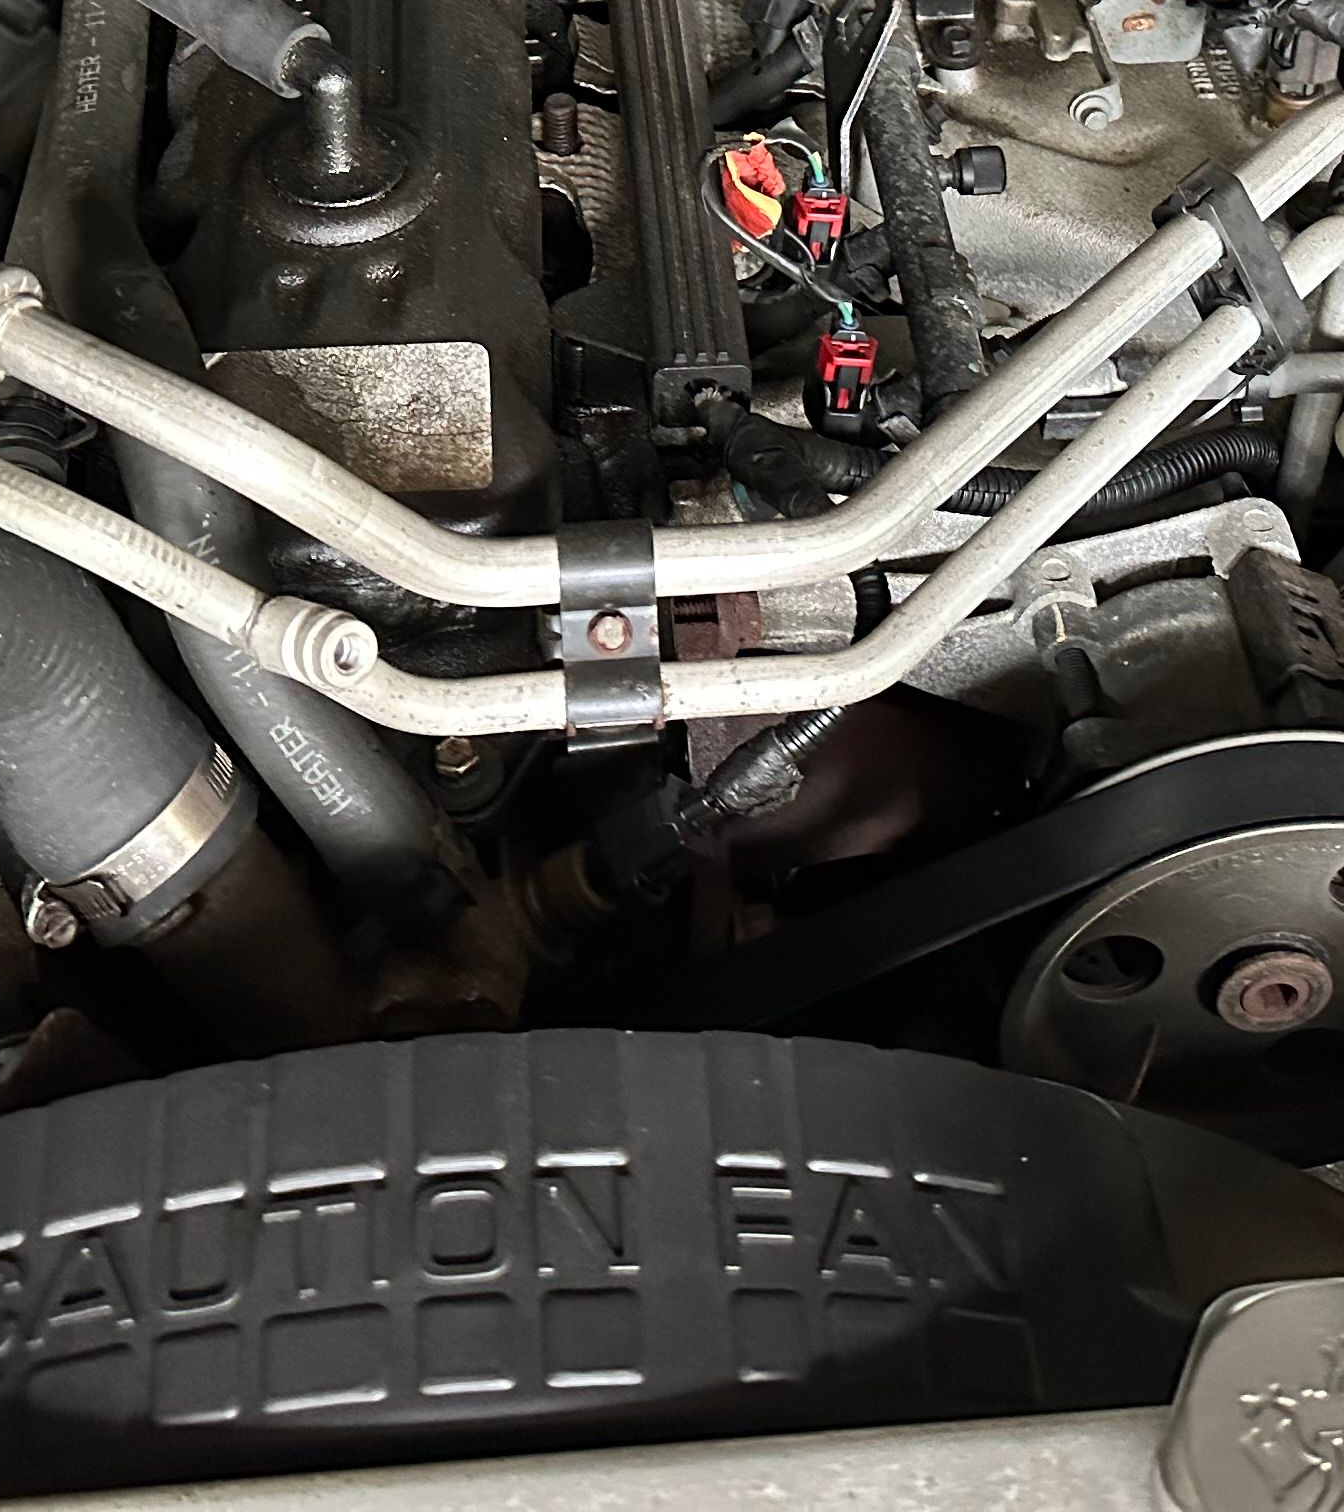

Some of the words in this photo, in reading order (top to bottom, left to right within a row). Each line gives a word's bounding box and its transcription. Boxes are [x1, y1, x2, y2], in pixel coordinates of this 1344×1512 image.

[75, 55, 101, 113] HEATER
[268, 716, 353, 816] HEATER
[719, 1172, 1023, 1295] FAN
